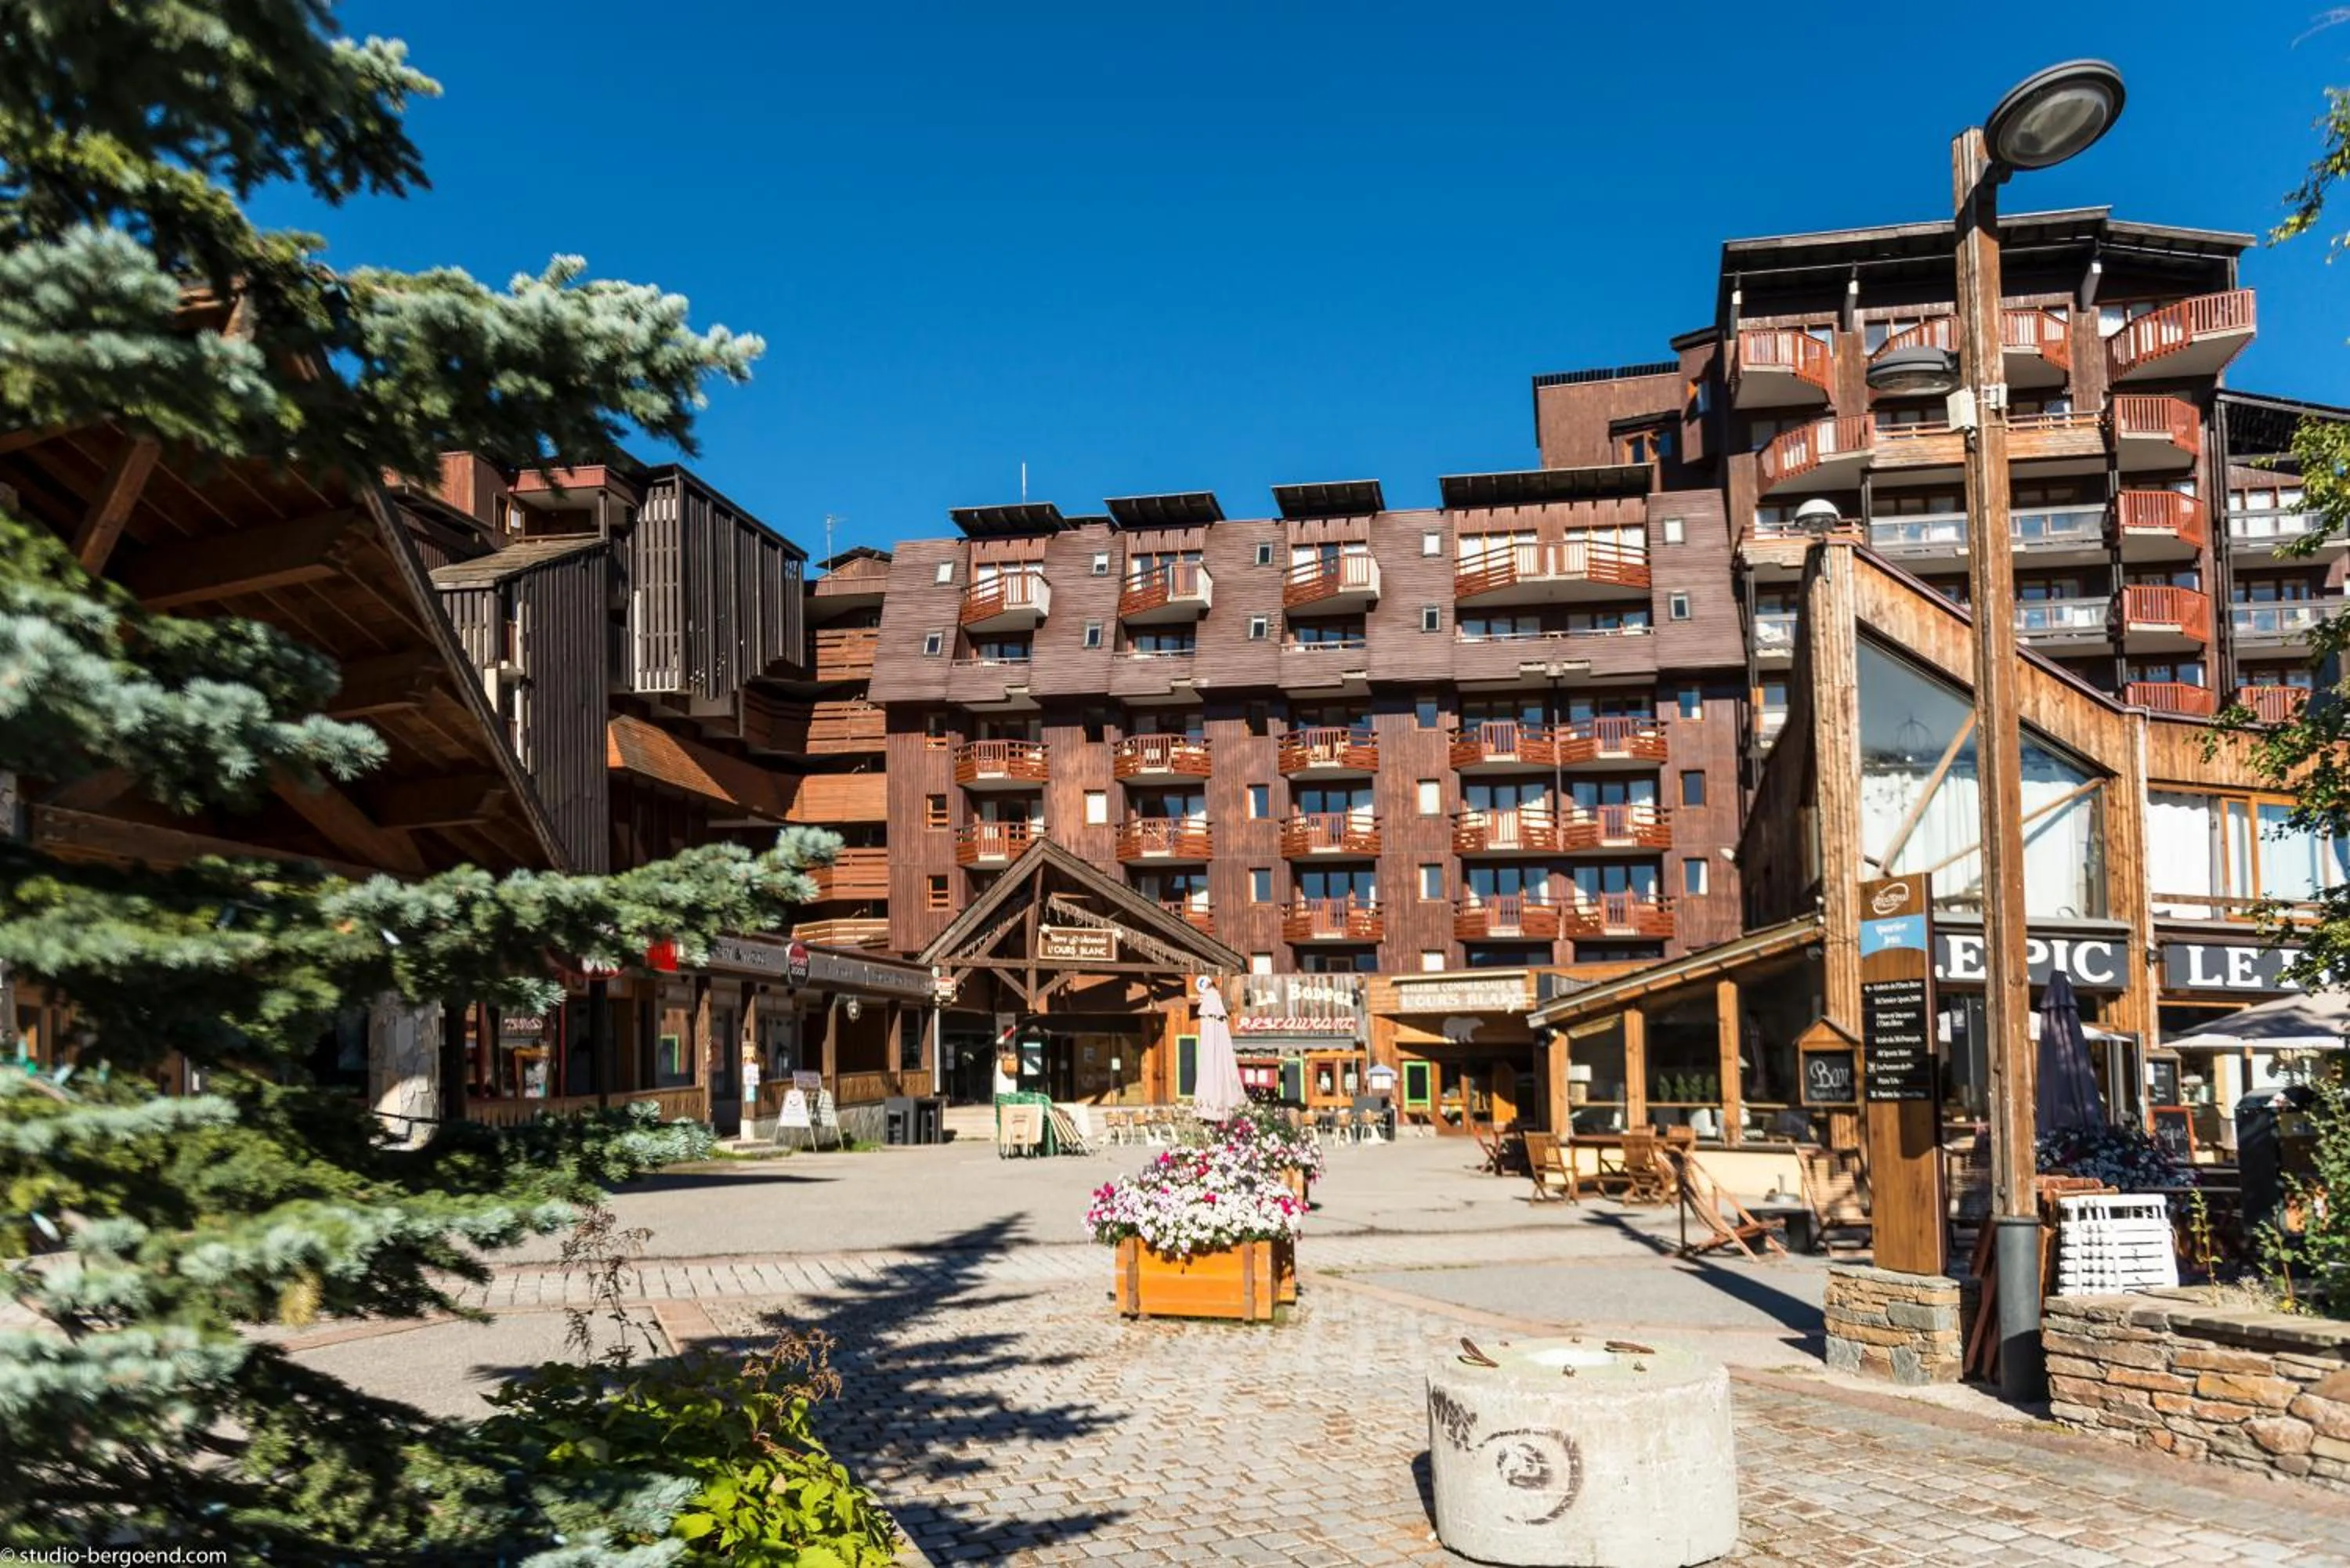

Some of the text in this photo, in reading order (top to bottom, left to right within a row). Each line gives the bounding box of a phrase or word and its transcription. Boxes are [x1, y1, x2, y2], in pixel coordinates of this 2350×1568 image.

[1079, 946, 1107, 956] BLANC
[1935, 934, 1986, 979] E
[2187, 945, 2262, 988] LE
[1810, 1060, 1849, 1088] Bar
